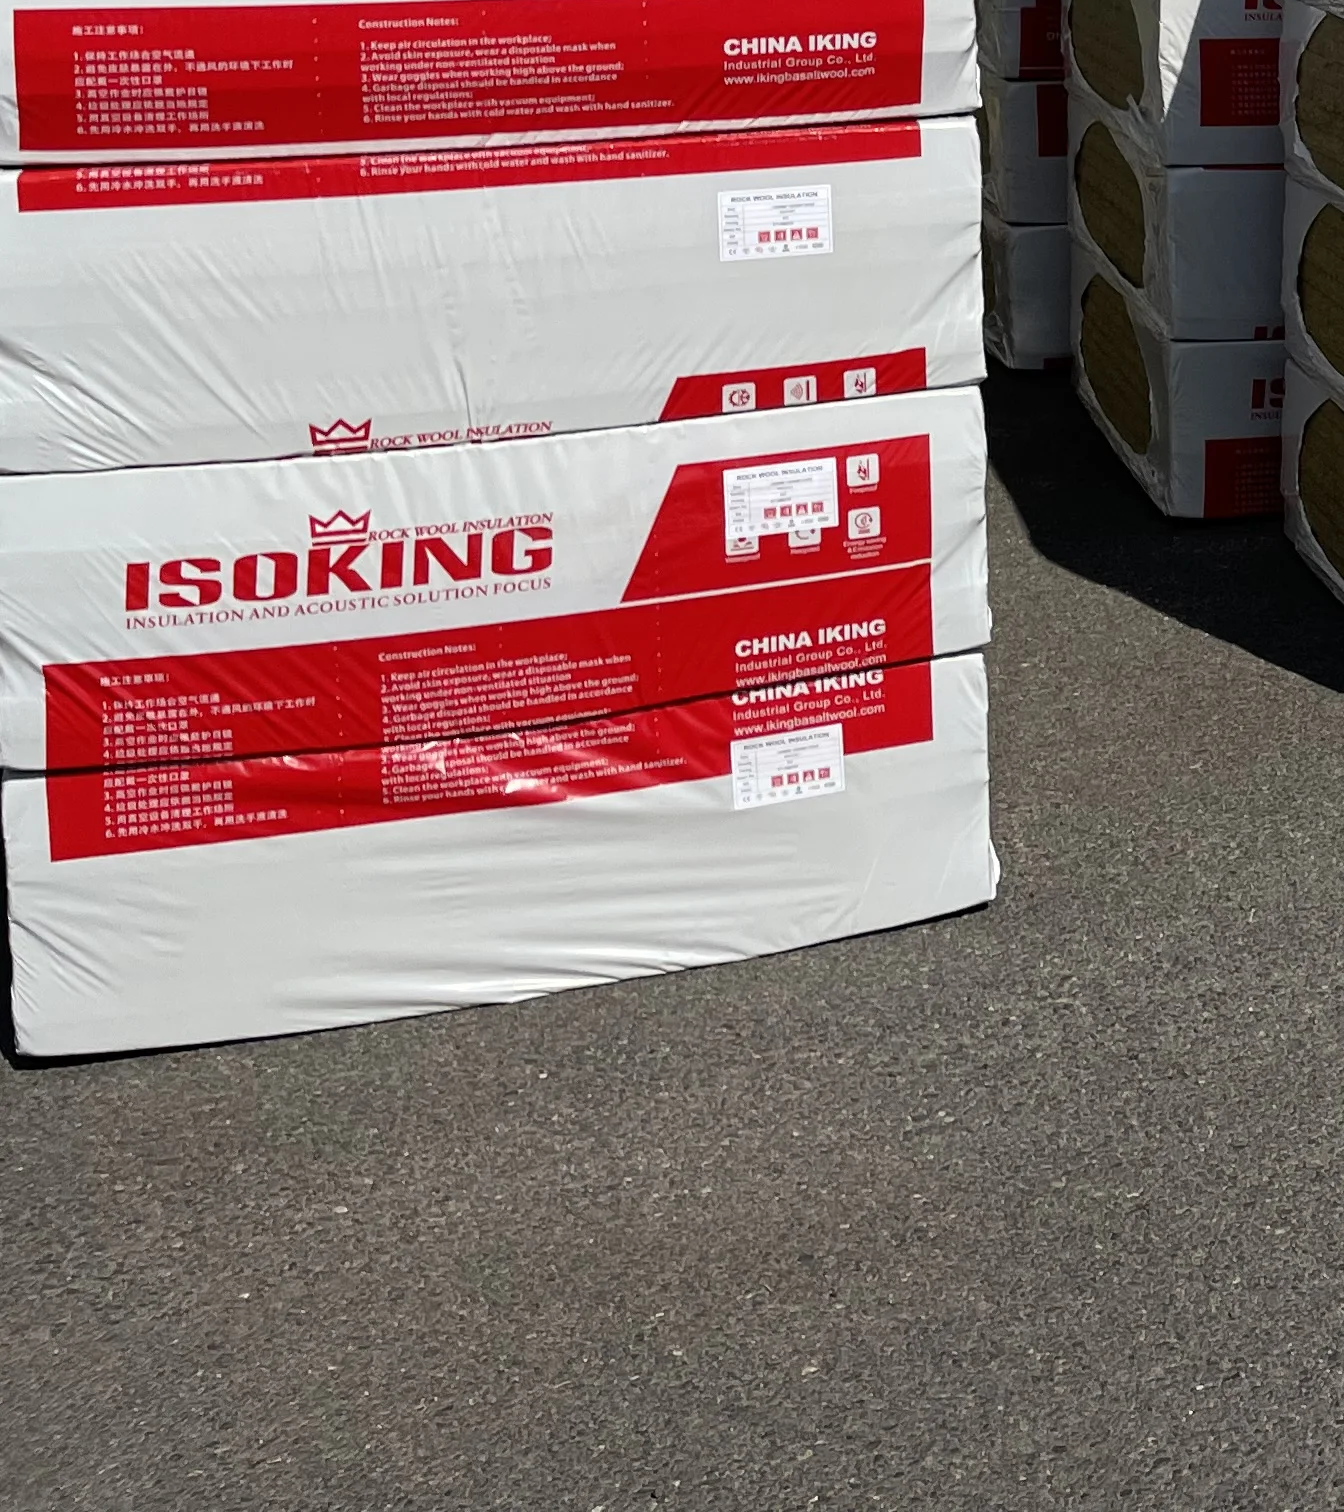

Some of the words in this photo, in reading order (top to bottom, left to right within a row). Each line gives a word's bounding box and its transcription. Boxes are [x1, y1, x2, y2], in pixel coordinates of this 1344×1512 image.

[358, 19, 425, 29] Construction
[425, 17, 458, 26] Notes:
[723, 36, 802, 55] CHINA
[808, 31, 876, 51] IKING
[723, 58, 781, 70] Industrial
[785, 57, 823, 67] Group
[369, 436, 411, 449] ROCK
[417, 429, 460, 445] WOOL
[466, 421, 552, 440] INSULATION
[369, 528, 410, 543] ROCK
[414, 523, 458, 536] WOOL
[462, 513, 552, 531] INSULATION
[125, 527, 553, 612] ISOKING
[126, 609, 243, 629] INSULATION
[249, 606, 290, 619] AND
[295, 596, 390, 616] ACOUSTIC
[394, 584, 488, 606] SOLUTION
[493, 578, 550, 594] FOCUS
[735, 631, 812, 657] CHINA
[818, 619, 885, 644] IKING
[735, 654, 792, 672] Industrial
[795, 650, 833, 663] Group
[731, 682, 809, 705] CHINA
[814, 669, 884, 693] IKING
[732, 703, 789, 720] Industrial
[793, 698, 831, 712] Group
[734, 704, 884, 735] www.ikingbasaltwool.com
